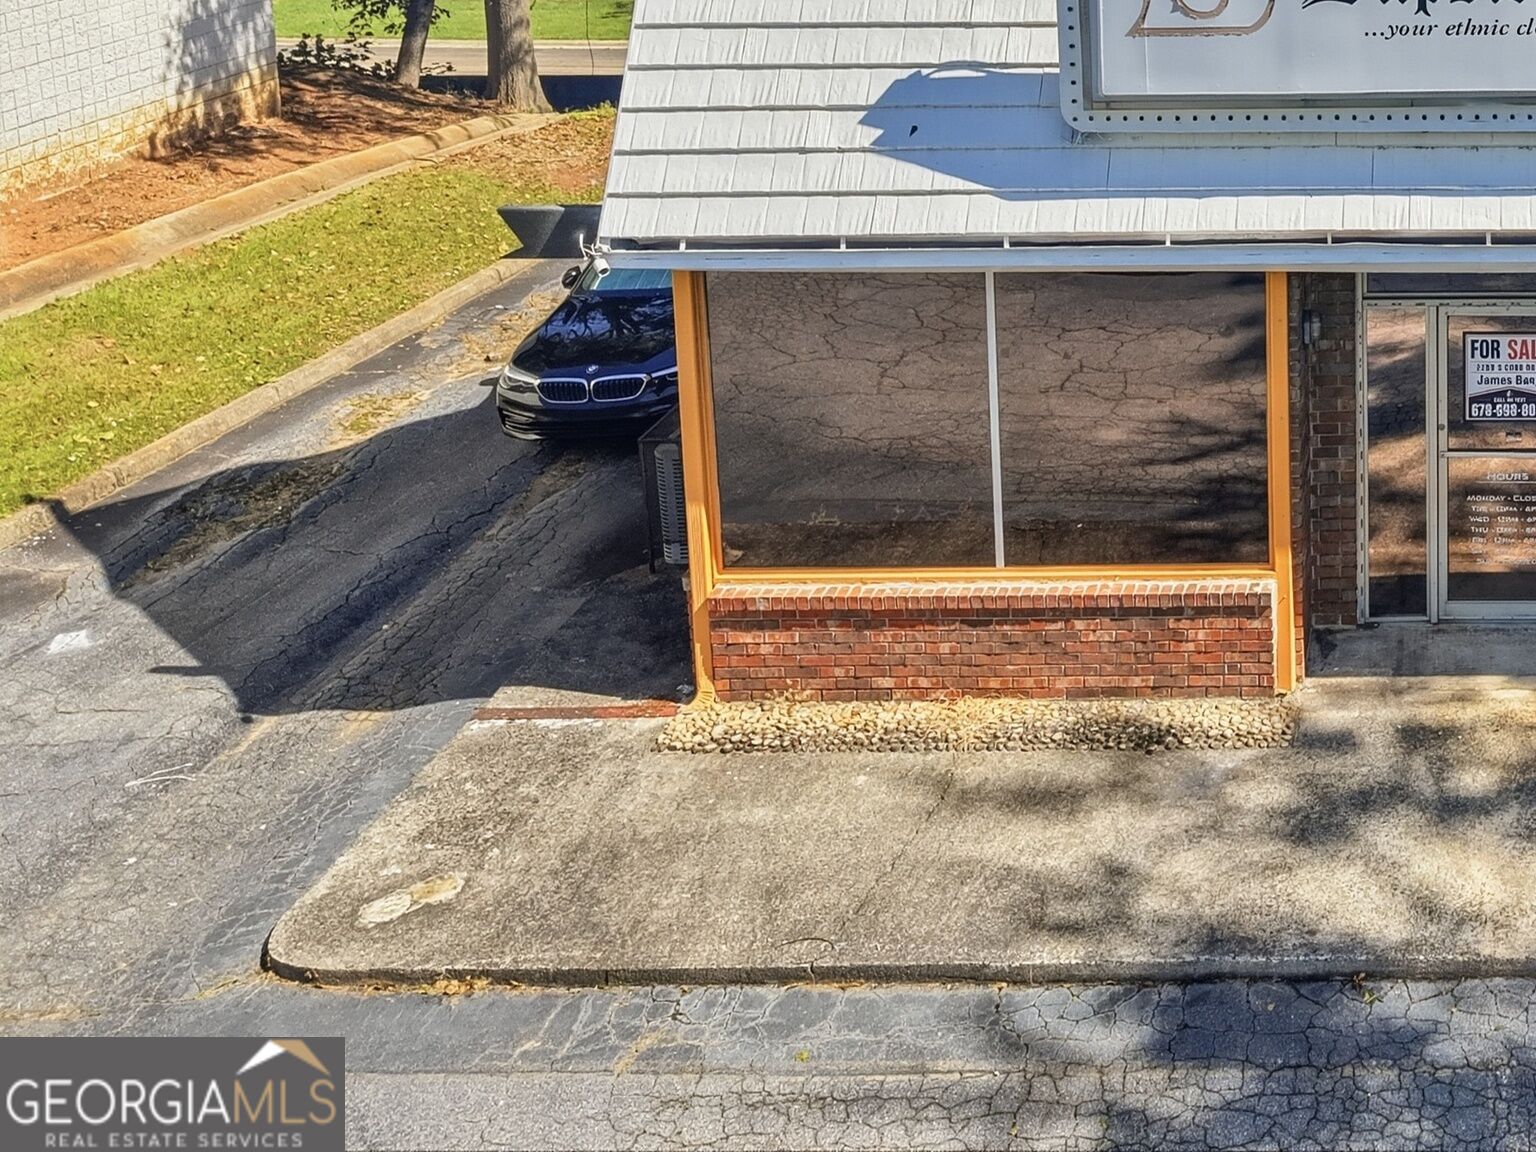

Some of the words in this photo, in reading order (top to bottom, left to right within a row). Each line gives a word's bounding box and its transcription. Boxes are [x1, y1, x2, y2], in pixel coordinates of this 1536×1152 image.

[1445, 18, 1509, 36] ethnic
[1470, 339, 1500, 359] FOR
[1477, 375, 1512, 385] James
[1487, 472, 1529, 481] HOURS
